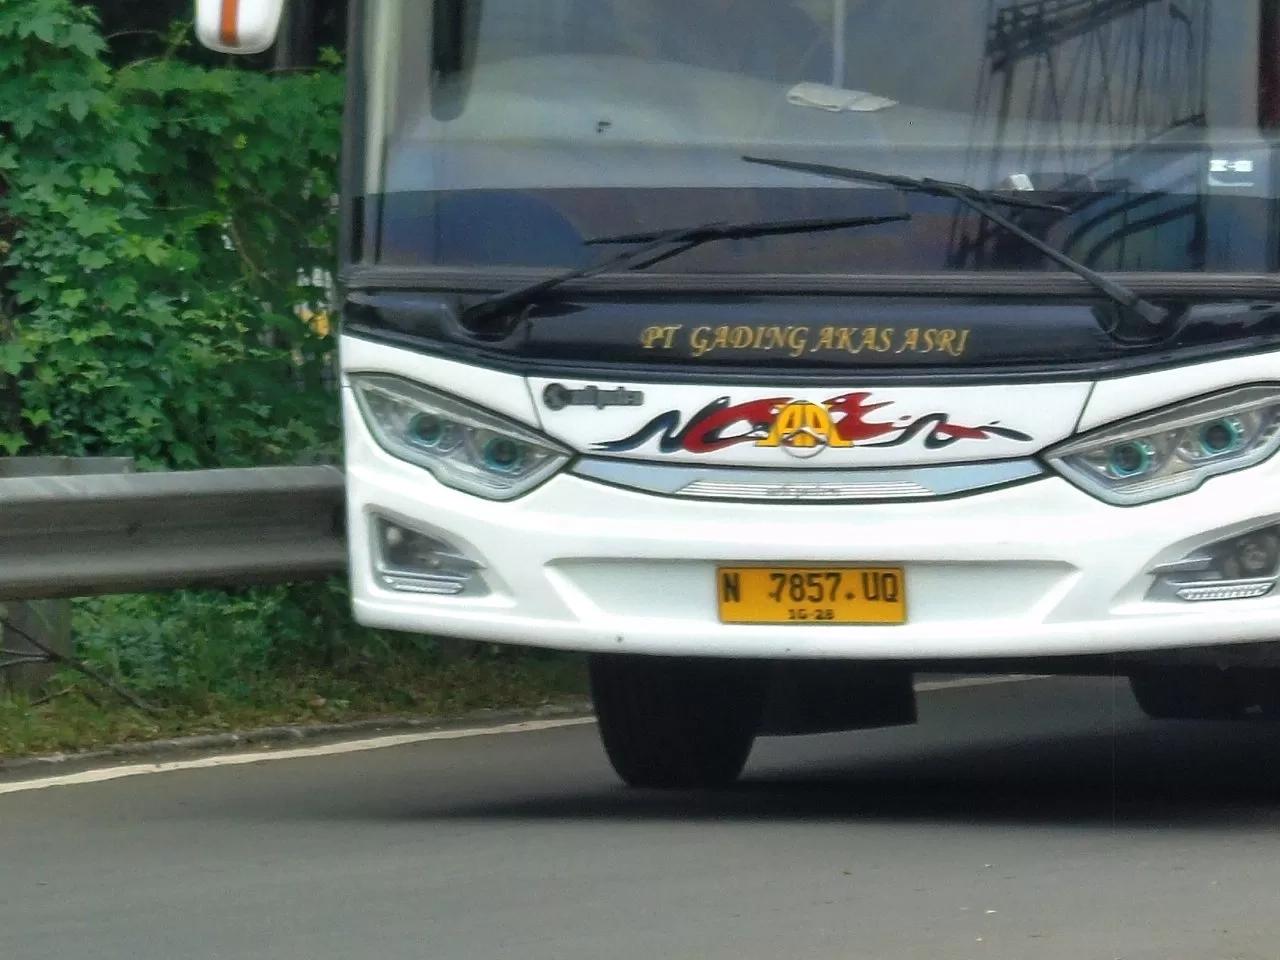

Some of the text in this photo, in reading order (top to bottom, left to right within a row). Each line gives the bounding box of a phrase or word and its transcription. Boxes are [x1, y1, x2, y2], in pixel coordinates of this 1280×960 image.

[641, 324, 971, 358] PT GADING AKAS ASRI
[723, 572, 899, 603] N 7857 UQ
